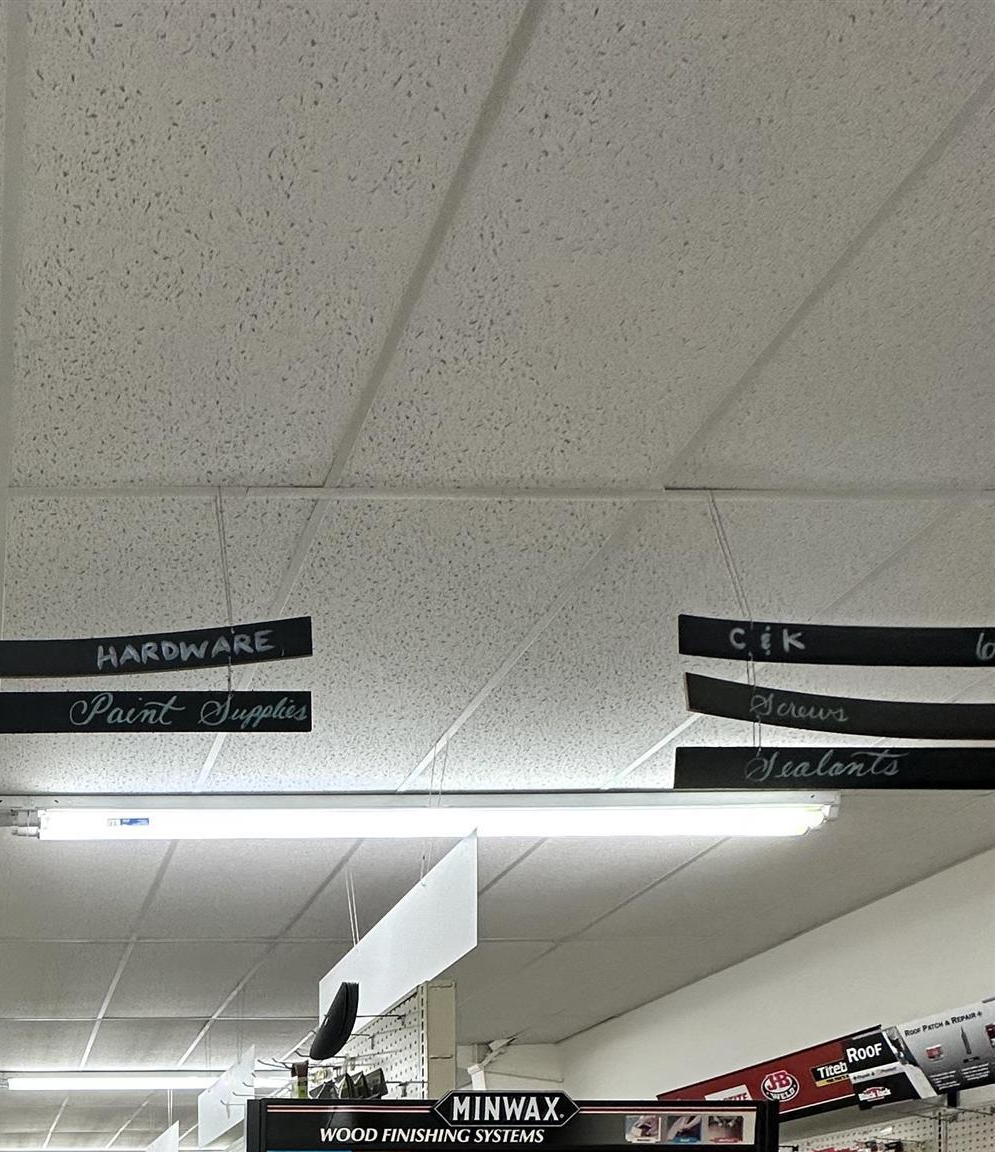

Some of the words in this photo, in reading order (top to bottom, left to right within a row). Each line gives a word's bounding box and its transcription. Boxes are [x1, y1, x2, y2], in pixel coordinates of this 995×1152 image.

[96, 629, 275, 671] HARDWARE
[69, 692, 186, 726] Paint
[197, 697, 308, 730] Supplies
[749, 693, 849, 722] Screws
[744, 749, 910, 782] Sealants
[846, 1043, 883, 1064] ROOF
[817, 1062, 849, 1080] Titeb
[452, 1095, 561, 1122] MINWAX
[320, 1128, 378, 1142] WOOD
[382, 1128, 470, 1143] FINISHING
[474, 1129, 545, 1143] SYSTEMS
